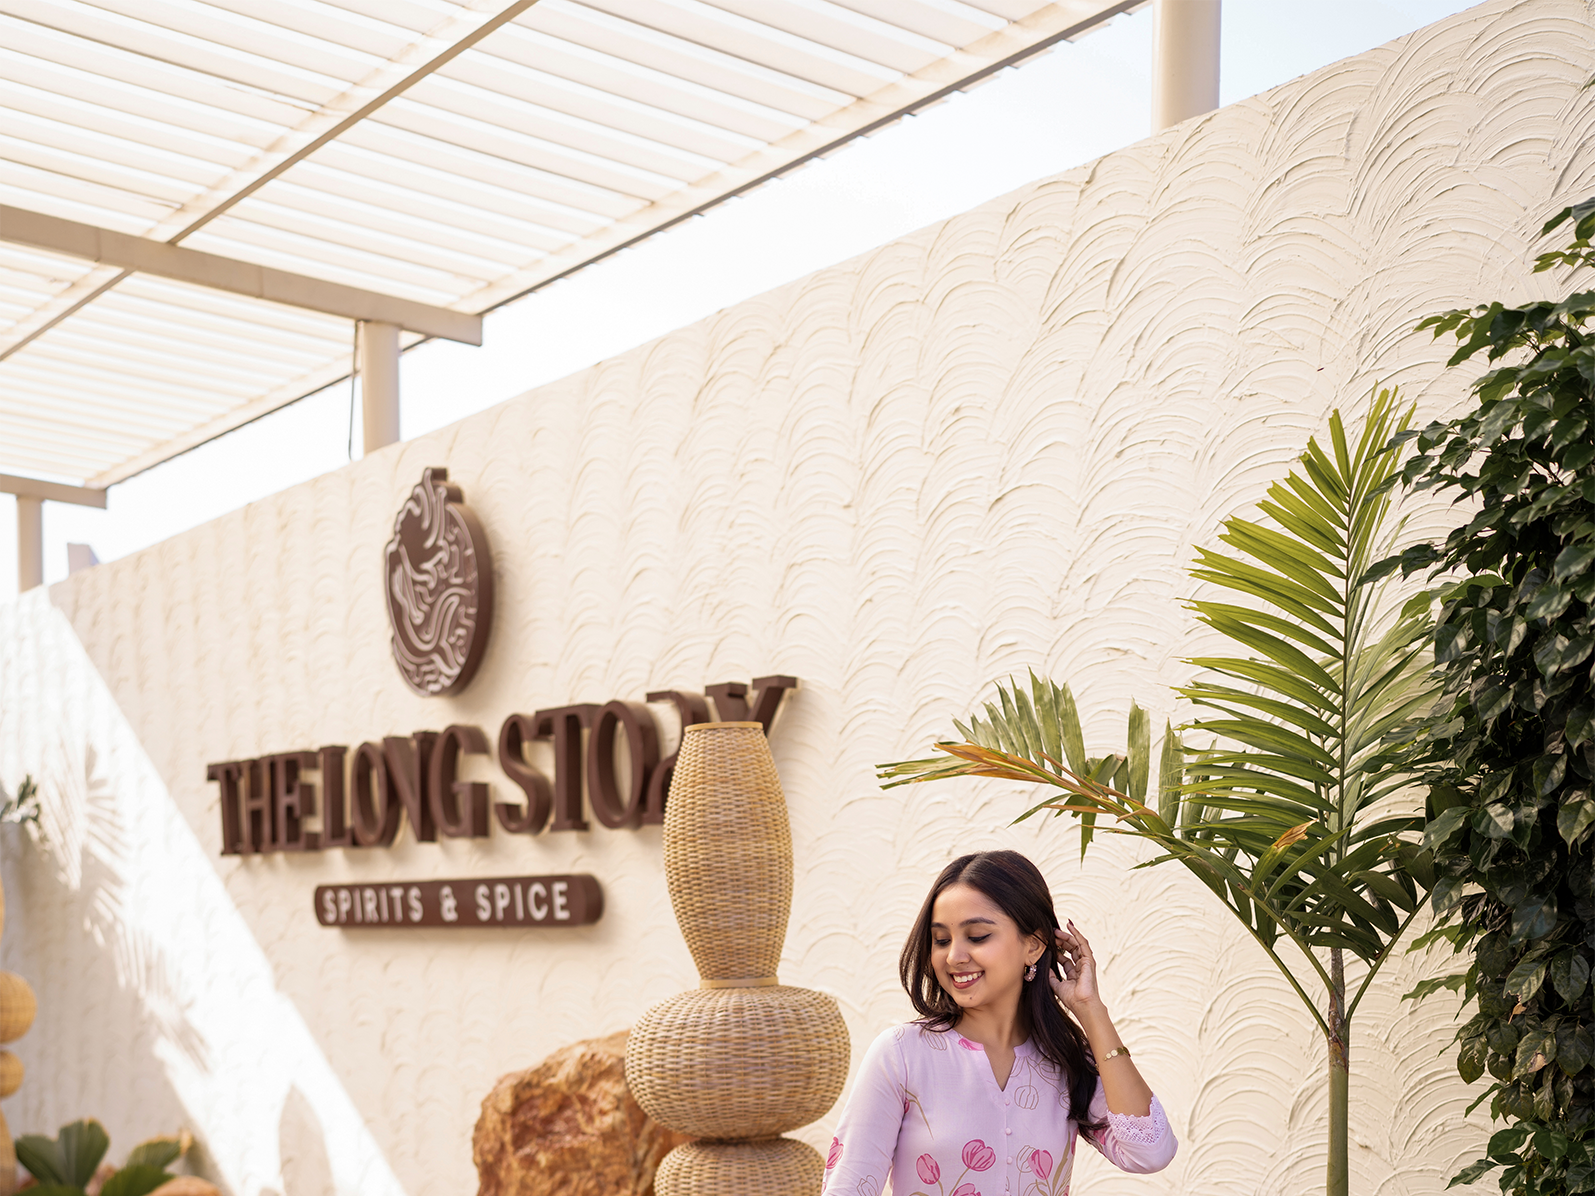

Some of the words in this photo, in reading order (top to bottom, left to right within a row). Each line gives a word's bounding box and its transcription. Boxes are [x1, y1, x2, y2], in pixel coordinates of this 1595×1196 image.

[318, 724, 490, 848] LONG
[322, 885, 424, 924] SPIRITS
[440, 885, 459, 923] &
[475, 880, 571, 921] SPICE
